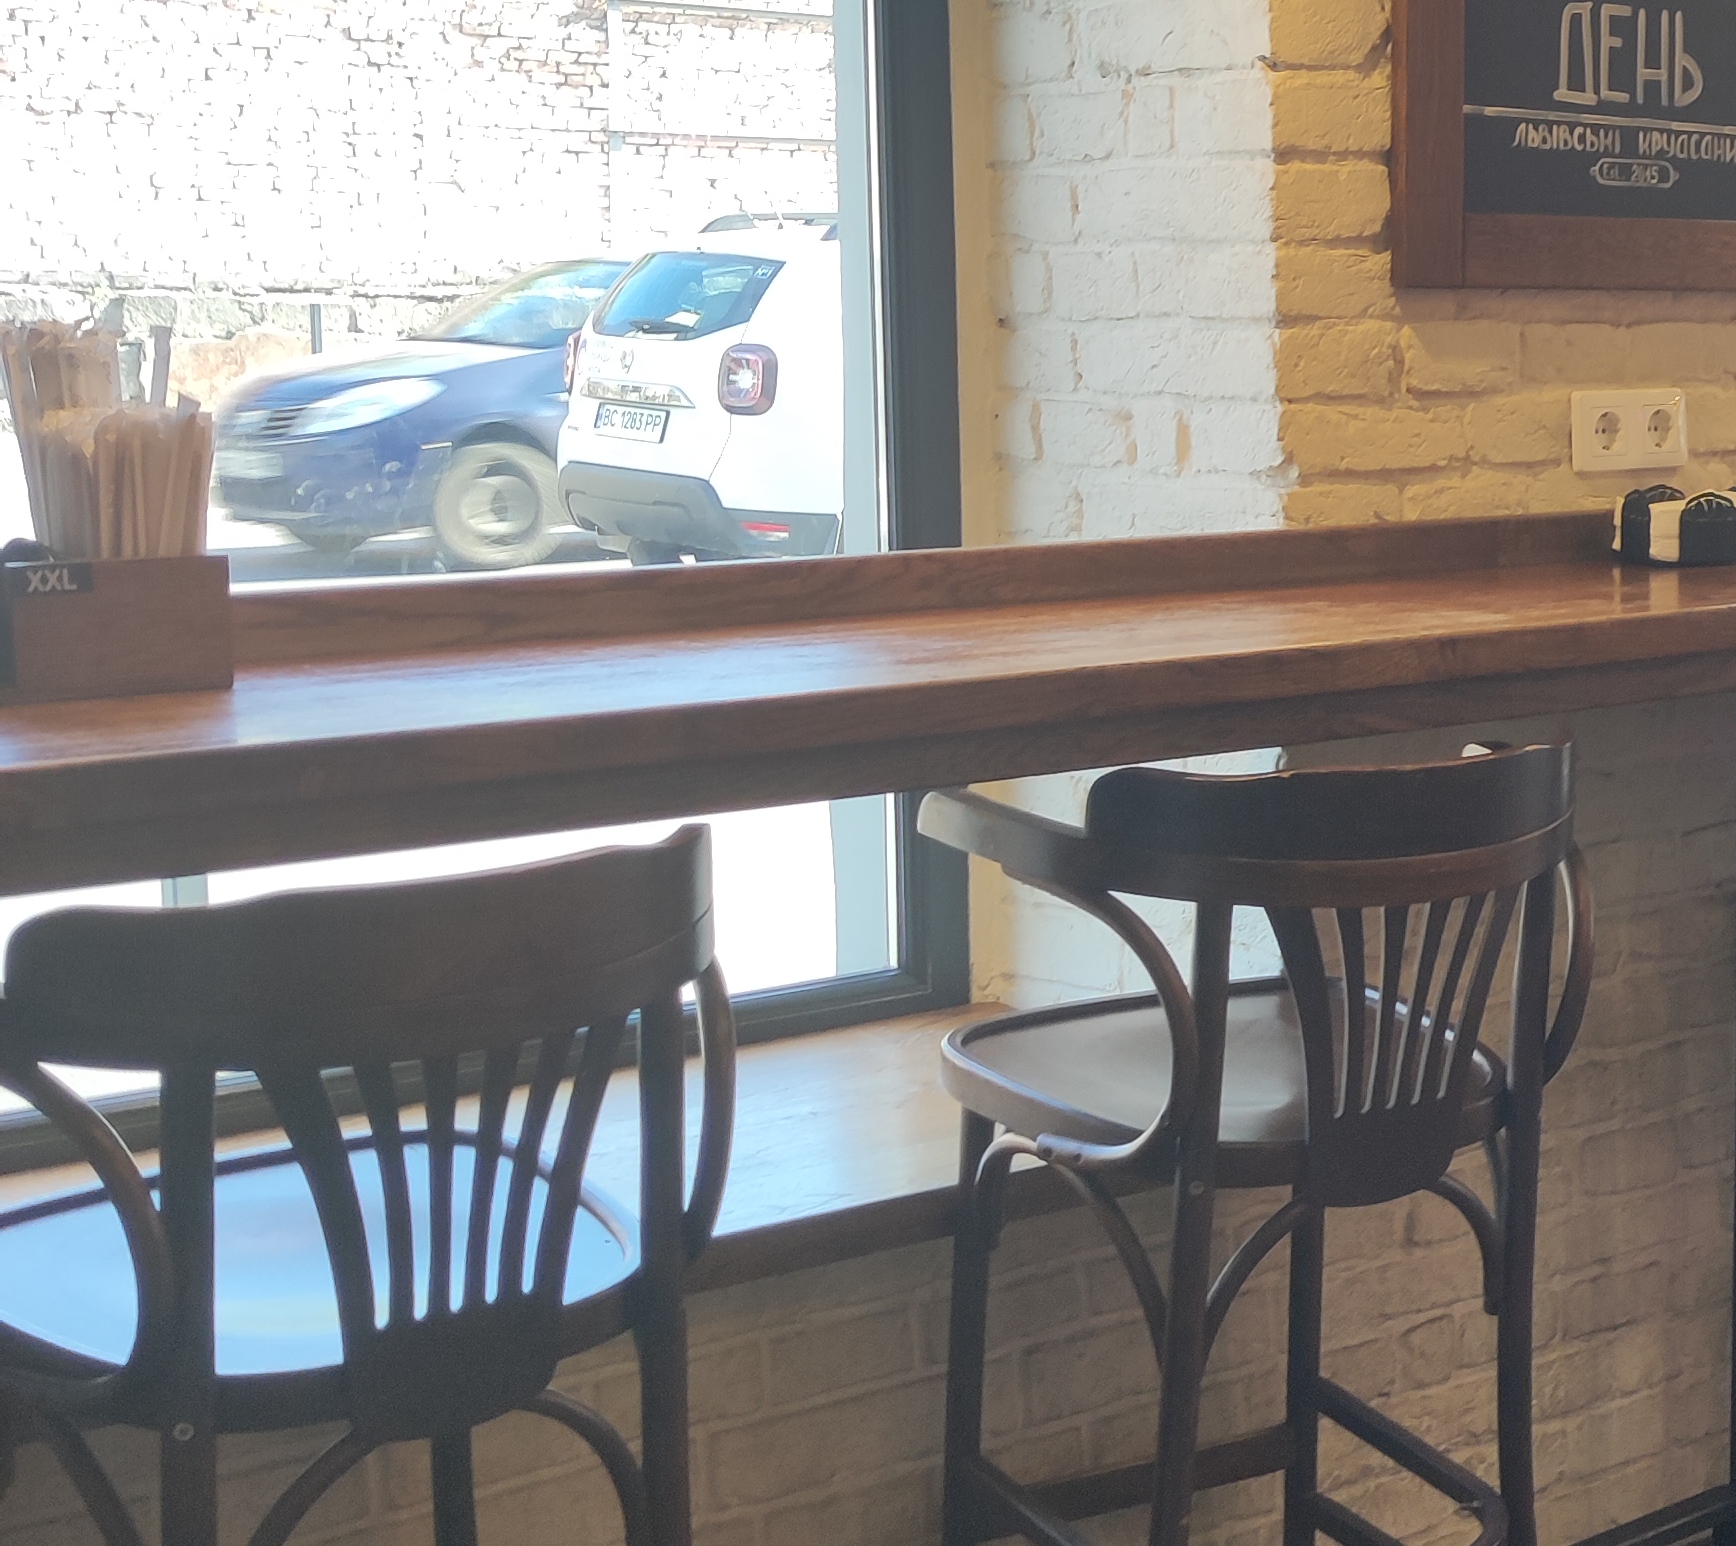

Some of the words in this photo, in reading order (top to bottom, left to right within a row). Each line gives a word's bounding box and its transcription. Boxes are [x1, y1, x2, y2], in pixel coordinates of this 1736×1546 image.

[1552, 1, 1704, 108] ДЕНЬ
[1511, 121, 1621, 154] ЛЬВІВСЬКІ
[603, 408, 619, 427] BC
[27, 568, 78, 593] XXL
